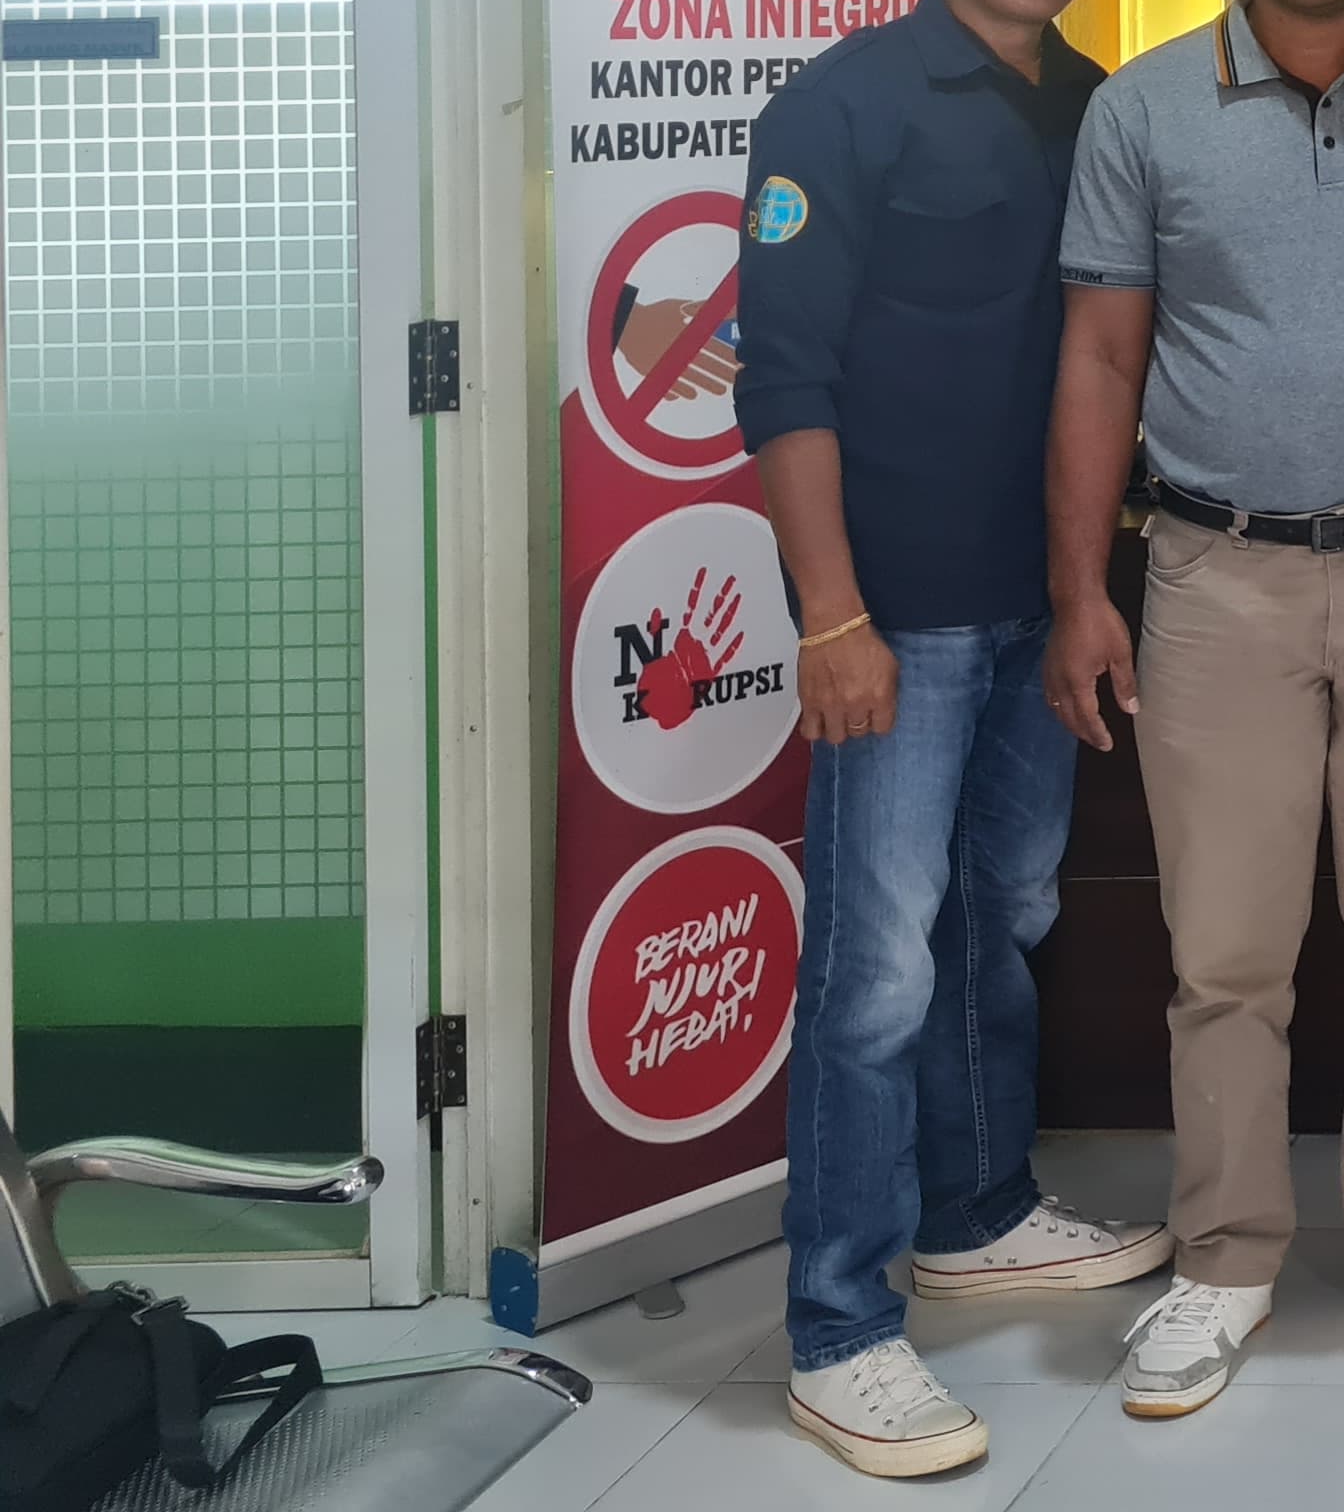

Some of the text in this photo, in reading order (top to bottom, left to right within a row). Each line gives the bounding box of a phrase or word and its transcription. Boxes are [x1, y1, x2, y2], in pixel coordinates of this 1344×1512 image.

[590, 58, 732, 99] KANTOR
[570, 118, 748, 164] KABUPATE
[635, 893, 759, 984] BERANI
